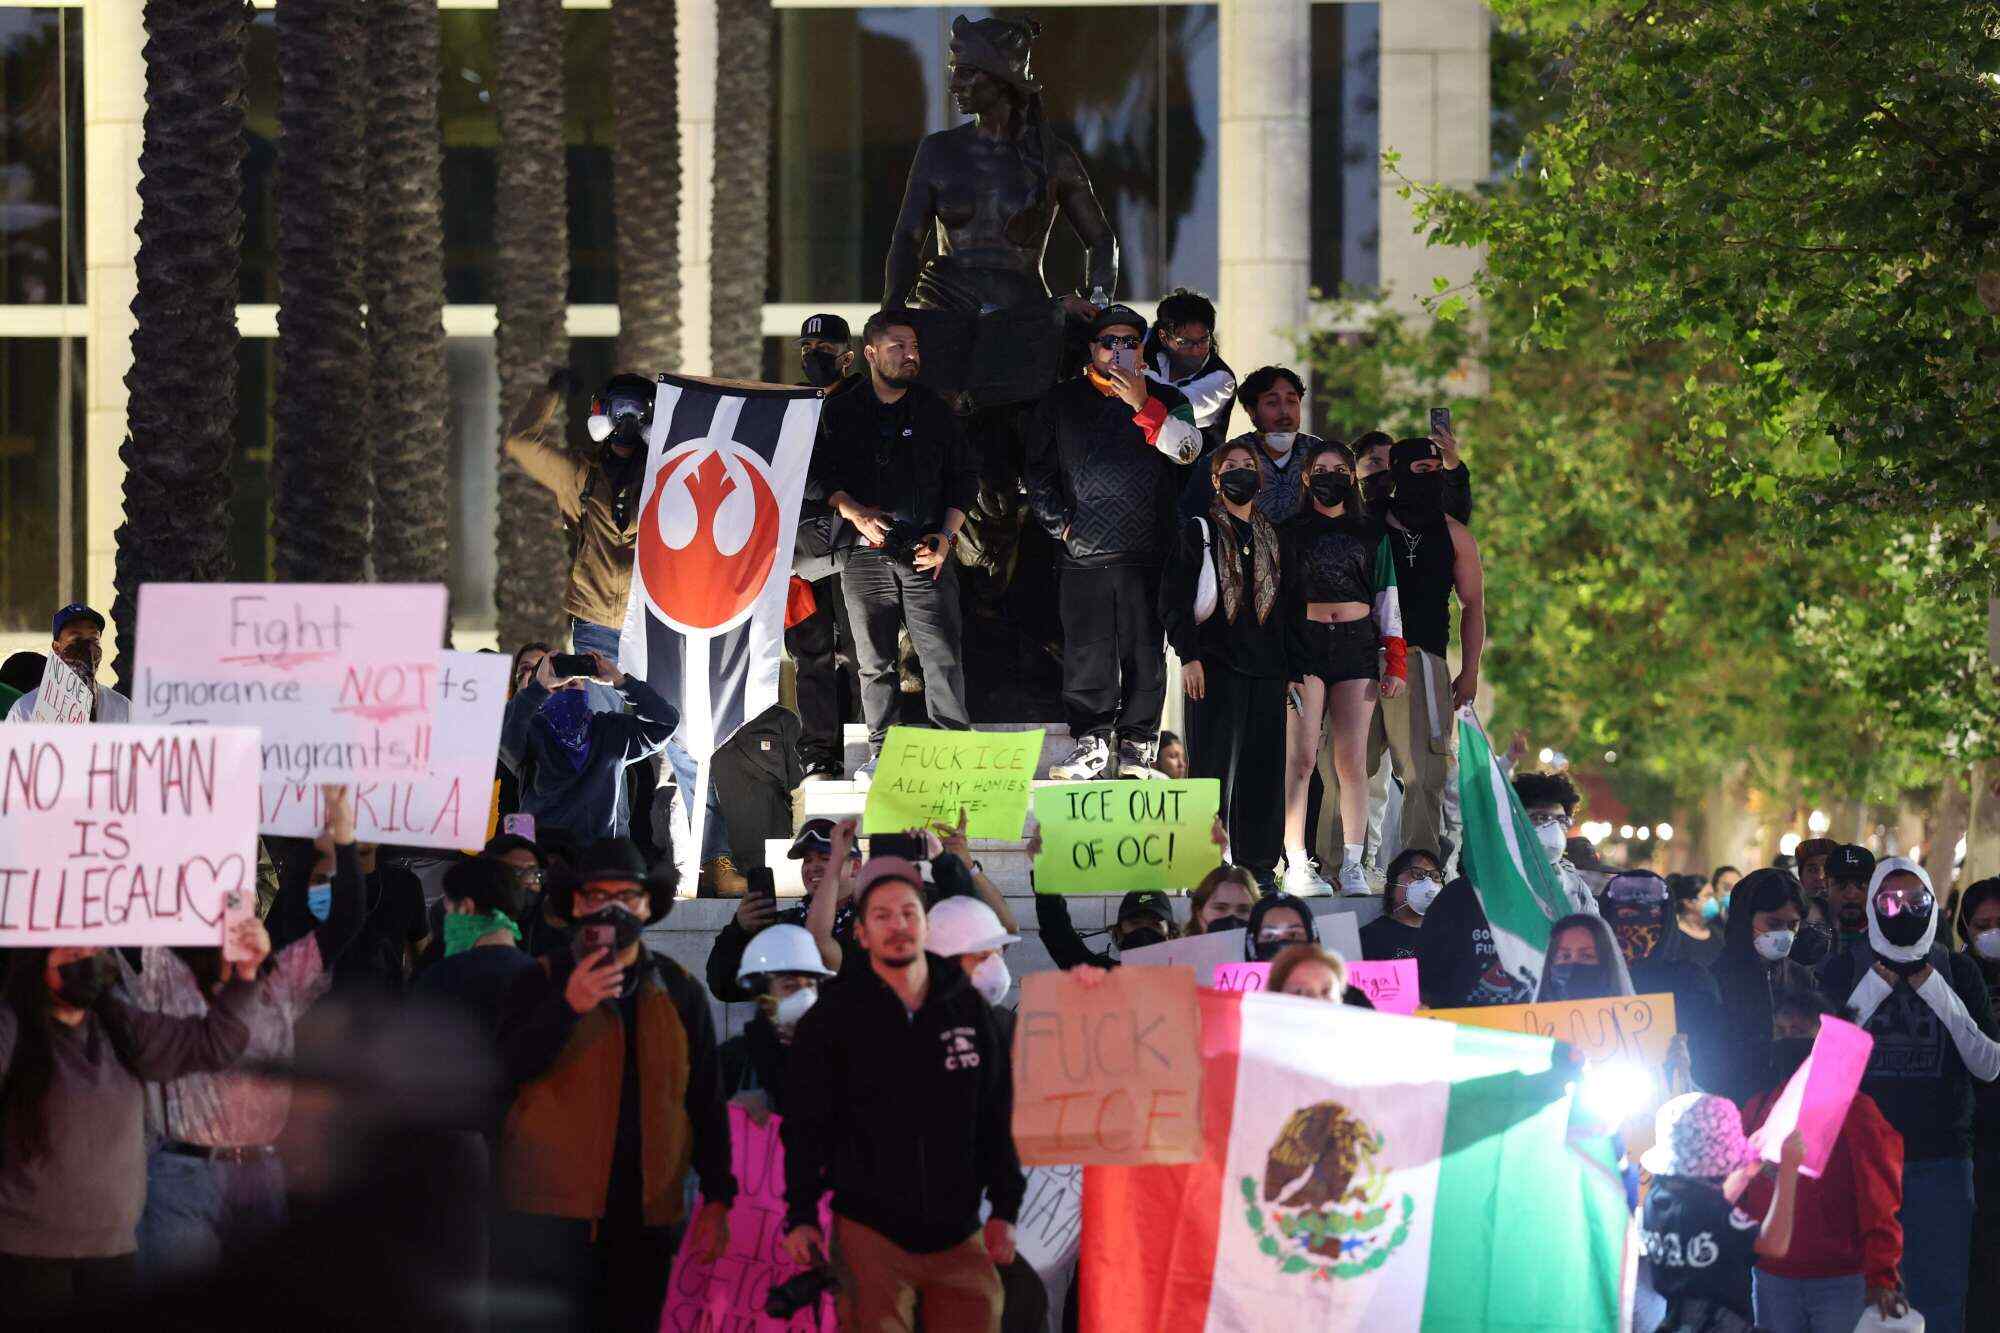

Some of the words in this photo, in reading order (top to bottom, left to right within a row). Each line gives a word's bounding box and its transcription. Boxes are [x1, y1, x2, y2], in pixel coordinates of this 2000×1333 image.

[230, 595, 354, 661] Fight
[145, 666, 301, 717] Ignorance
[338, 664, 436, 710] NOT
[2, 742, 64, 815] NO
[87, 736, 217, 816] HUMAN
[900, 744, 968, 770] FUCK
[974, 745, 1025, 770] ICE
[889, 777, 929, 793] ALL
[939, 780, 968, 795] MY
[973, 778, 1027, 793] HOMIES
[1065, 789, 1114, 824] ICE
[1128, 789, 1188, 823] OUT
[69, 820, 130, 860] IS
[1072, 838, 1104, 871] OF
[1116, 831, 1176, 871] OC!
[0, 864, 187, 931] ILLEGAL!
[1351, 965, 1401, 996] llegal
[1021, 1008, 1172, 1084] FUCK
[1043, 1087, 1189, 1154] ICE
